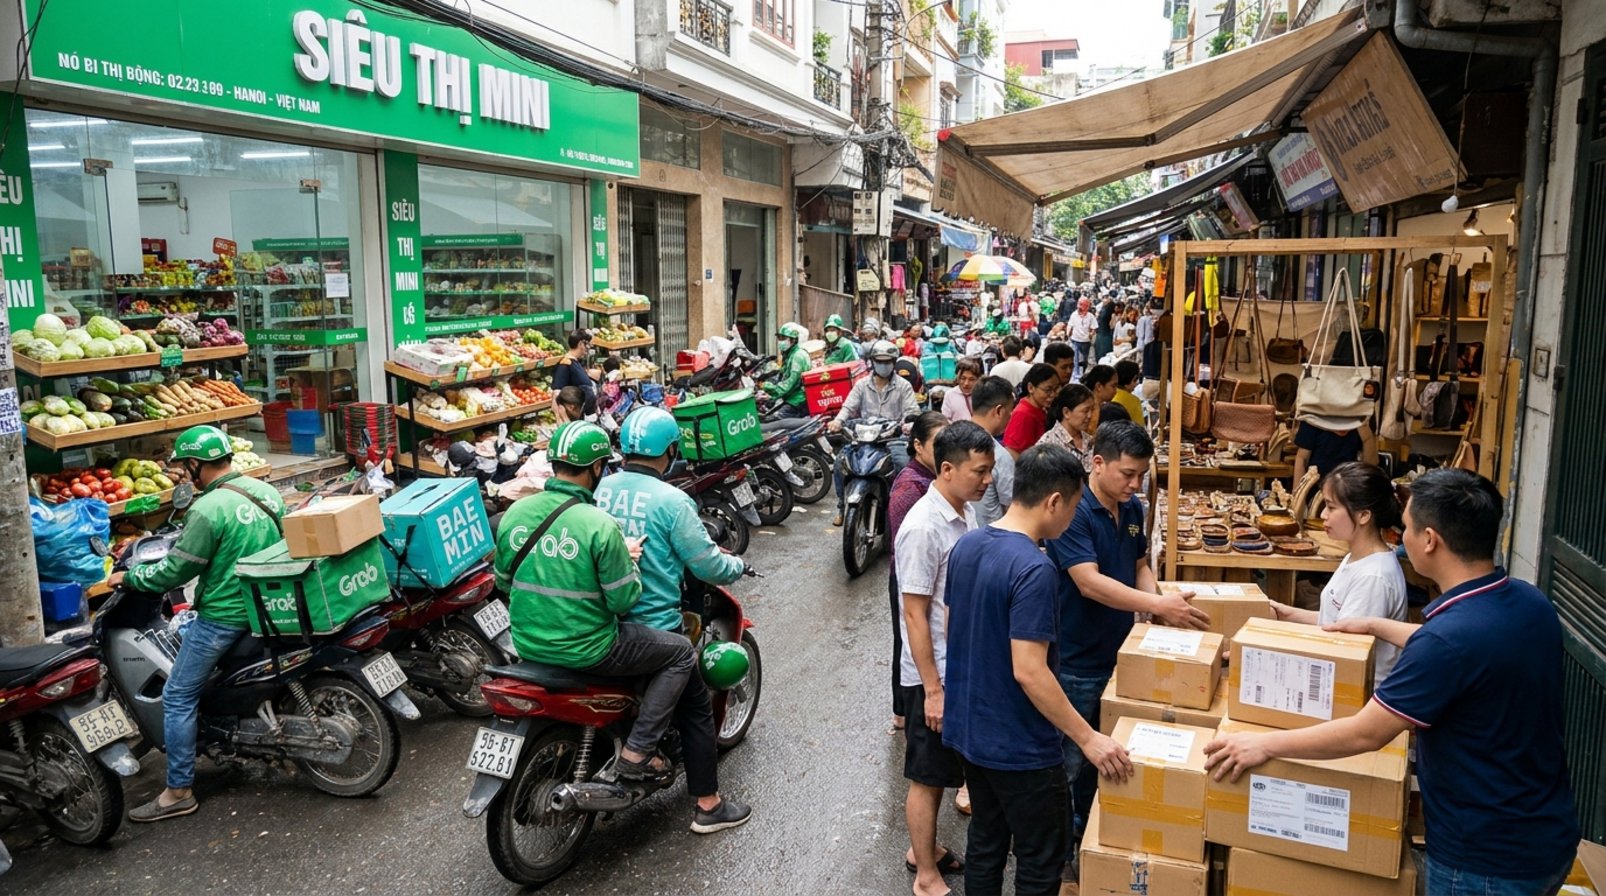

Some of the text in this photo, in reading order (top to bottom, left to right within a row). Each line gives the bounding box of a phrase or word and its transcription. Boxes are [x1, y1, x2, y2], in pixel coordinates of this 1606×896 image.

[57, 51, 80, 70] NÓ
[101, 60, 122, 81] THỊ
[234, 85, 266, 104] HANOI
[276, 93, 296, 111] VIỆT
[299, 97, 320, 114] NAM
[293, 9, 550, 130] SIÊU THỊ MINI
[0, 169, 23, 205] ÊU
[0, 226, 23, 262] HỊ
[397, 237, 415, 261] THỊ
[5, 279, 35, 308] INI
[395, 272, 419, 291] MINI
[727, 412, 756, 436] Grab
[436, 496, 479, 541] BAE
[597, 487, 651, 519] BAE
[443, 519, 485, 566] MIN
[510, 525, 579, 560] Gab
[339, 562, 378, 597] Grab
